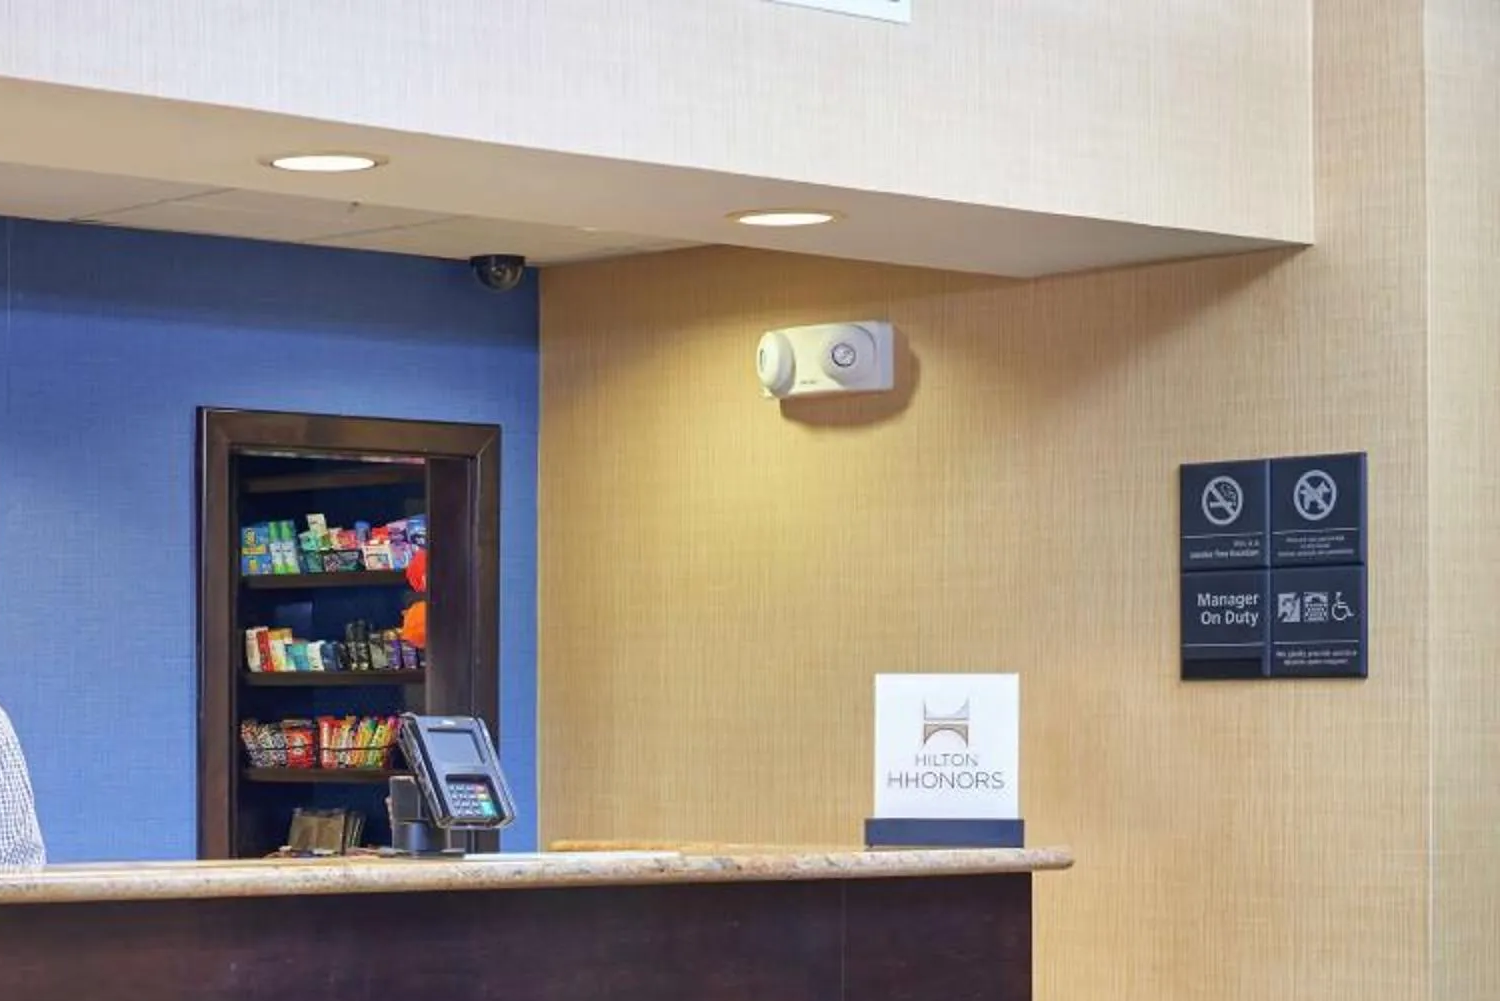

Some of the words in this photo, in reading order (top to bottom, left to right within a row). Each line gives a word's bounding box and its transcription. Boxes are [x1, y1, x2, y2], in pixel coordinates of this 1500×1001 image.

[1197, 592, 1260, 609] Manager
[1201, 610, 1221, 625] On
[1225, 609, 1259, 627] Duty
[915, 753, 978, 767] HILTON
[887, 770, 1005, 789] HHONORS
